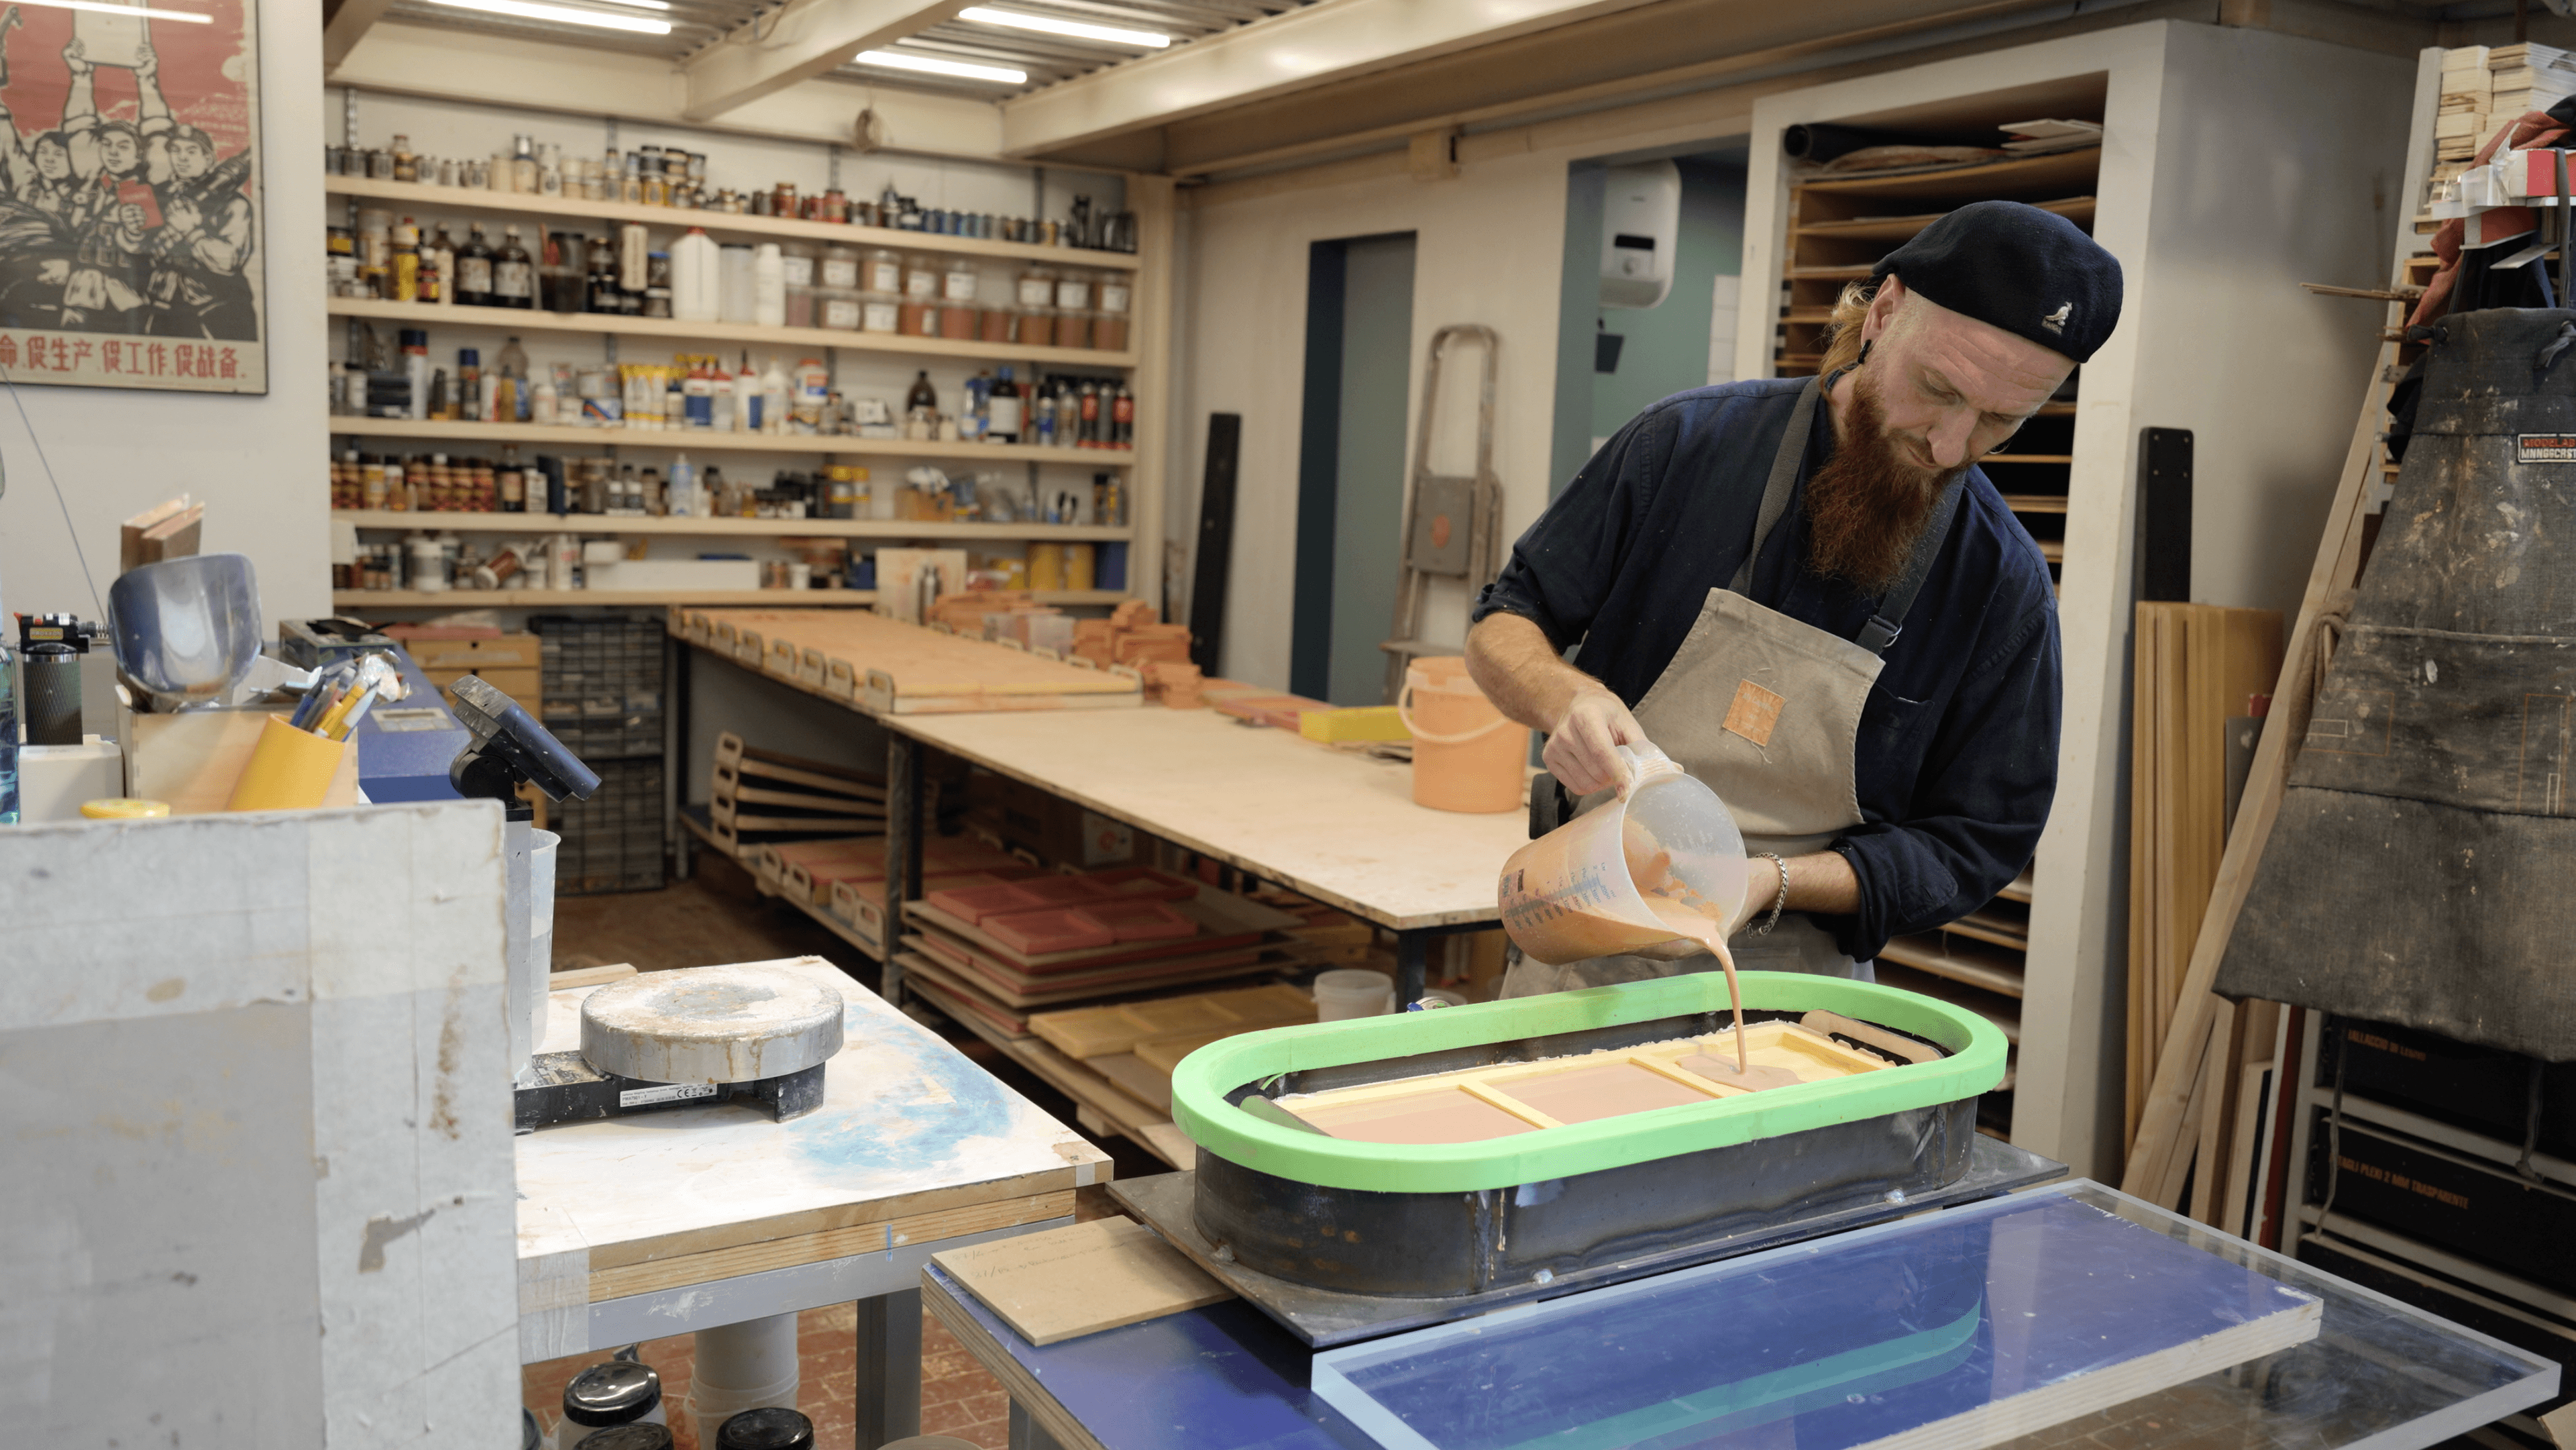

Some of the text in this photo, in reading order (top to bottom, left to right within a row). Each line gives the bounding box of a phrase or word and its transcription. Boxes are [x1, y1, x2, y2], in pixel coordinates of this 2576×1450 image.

[1601, 884, 1611, 899] 2000
[2359, 1162, 2383, 1180] PLEXI
[2383, 1170, 2391, 1183] 2
[2412, 1180, 2469, 1210] TRASPARENTE
